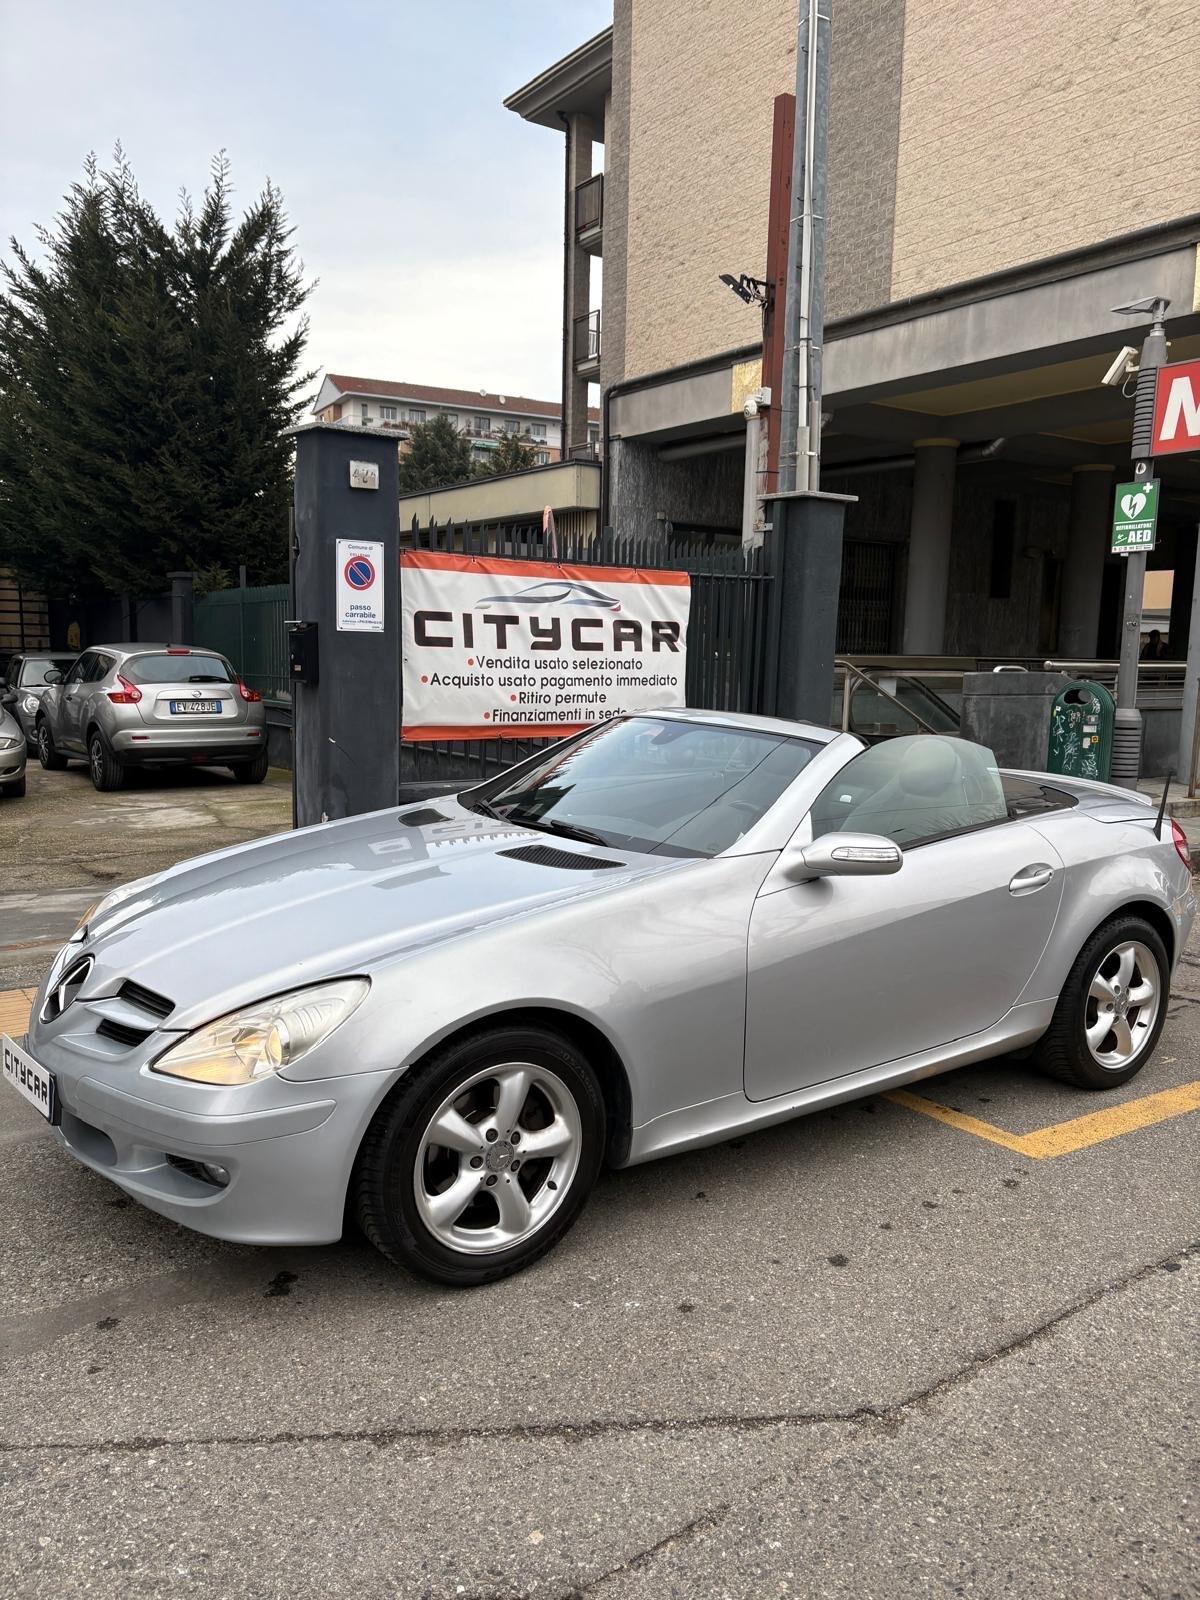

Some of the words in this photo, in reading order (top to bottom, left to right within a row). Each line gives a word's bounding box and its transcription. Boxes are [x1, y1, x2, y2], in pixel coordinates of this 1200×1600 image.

[1159, 376, 1200, 441] M
[1128, 530, 1152, 543] AED
[413, 611, 681, 652] CITYCAR
[476, 656, 530, 669] Vendita
[535, 658, 569, 669] usato
[572, 657, 643, 670] selezionato
[430, 673, 494, 689] Acquisto
[498, 674, 537, 687] usato
[540, 674, 613, 689] pagamento
[616, 674, 678, 687] immediato
[519, 691, 551, 704] Ritiro
[555, 691, 607, 706] permute
[492, 708, 581, 722] Finanziamenti
[585, 708, 595, 720] in
[4, 1048, 48, 1105] CITYCAR
